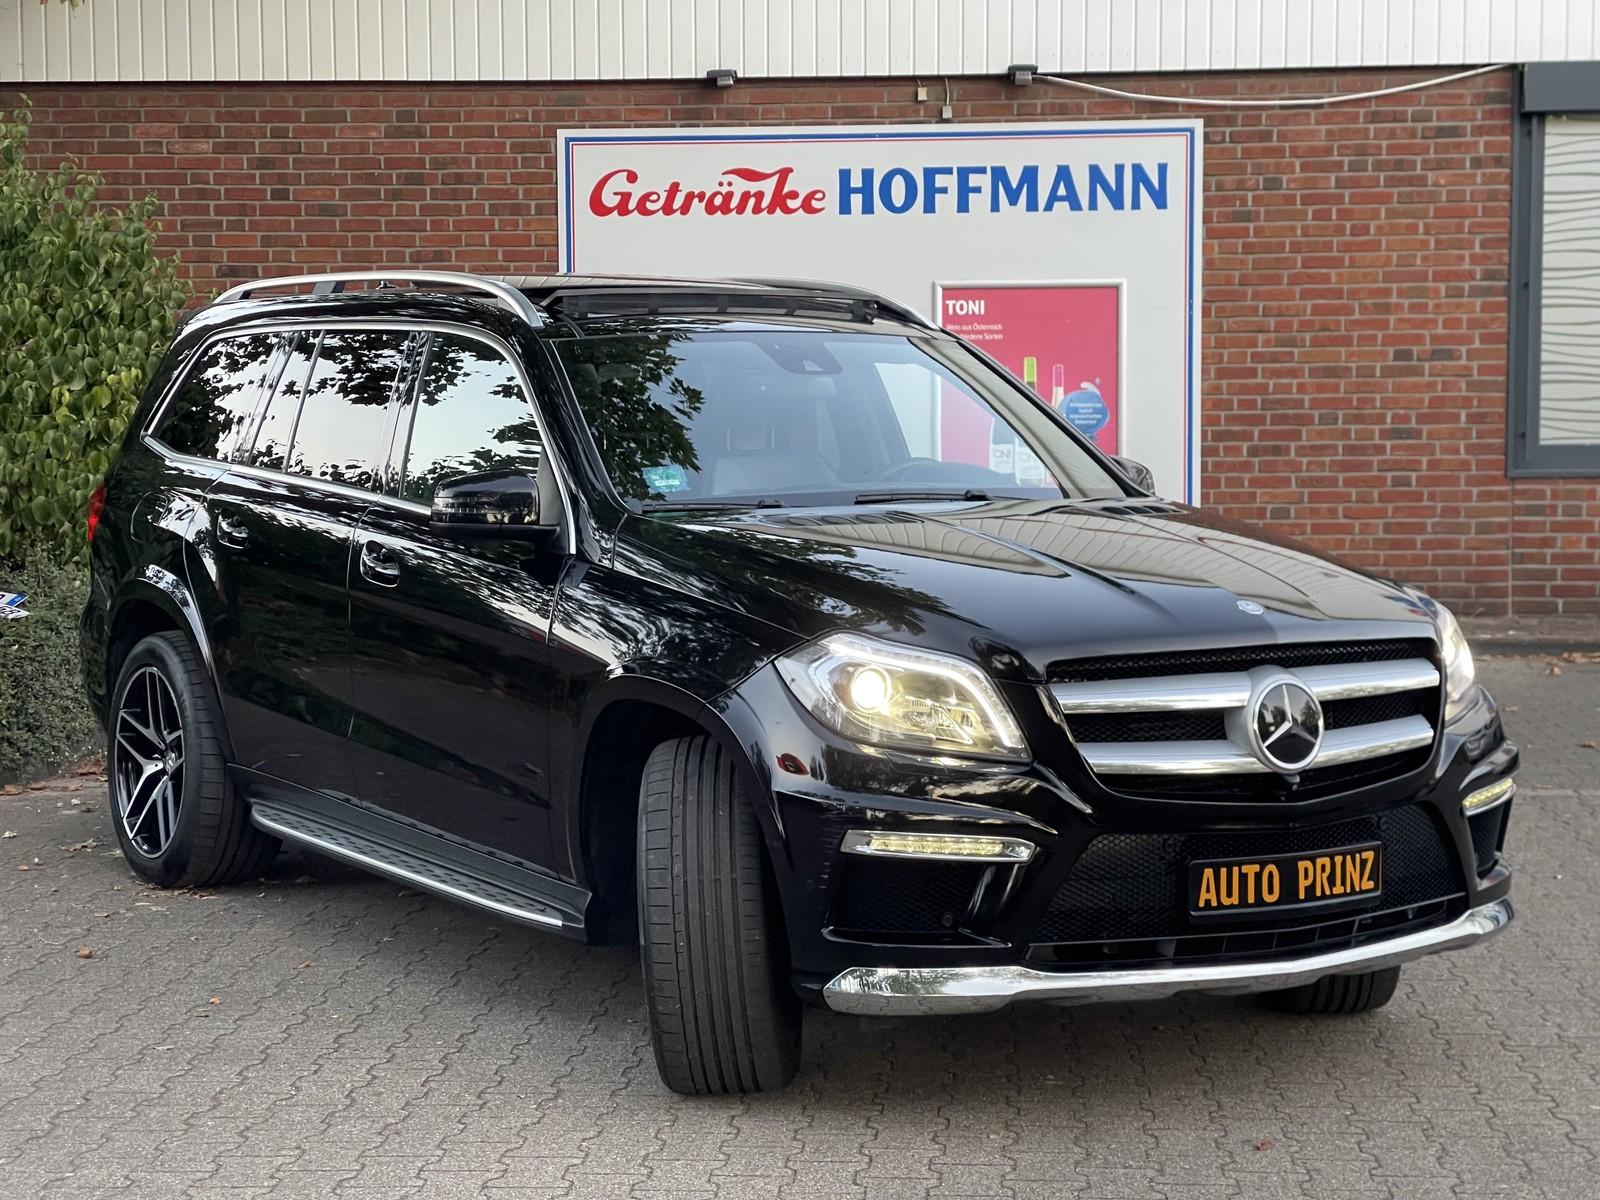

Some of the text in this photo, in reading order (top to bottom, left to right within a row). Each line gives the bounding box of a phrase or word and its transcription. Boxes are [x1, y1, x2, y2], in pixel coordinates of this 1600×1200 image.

[588, 162, 1169, 217] Getränke HOFFMANN
[945, 299, 985, 315] TONI
[1198, 850, 1375, 908] AUTO PRINZ
